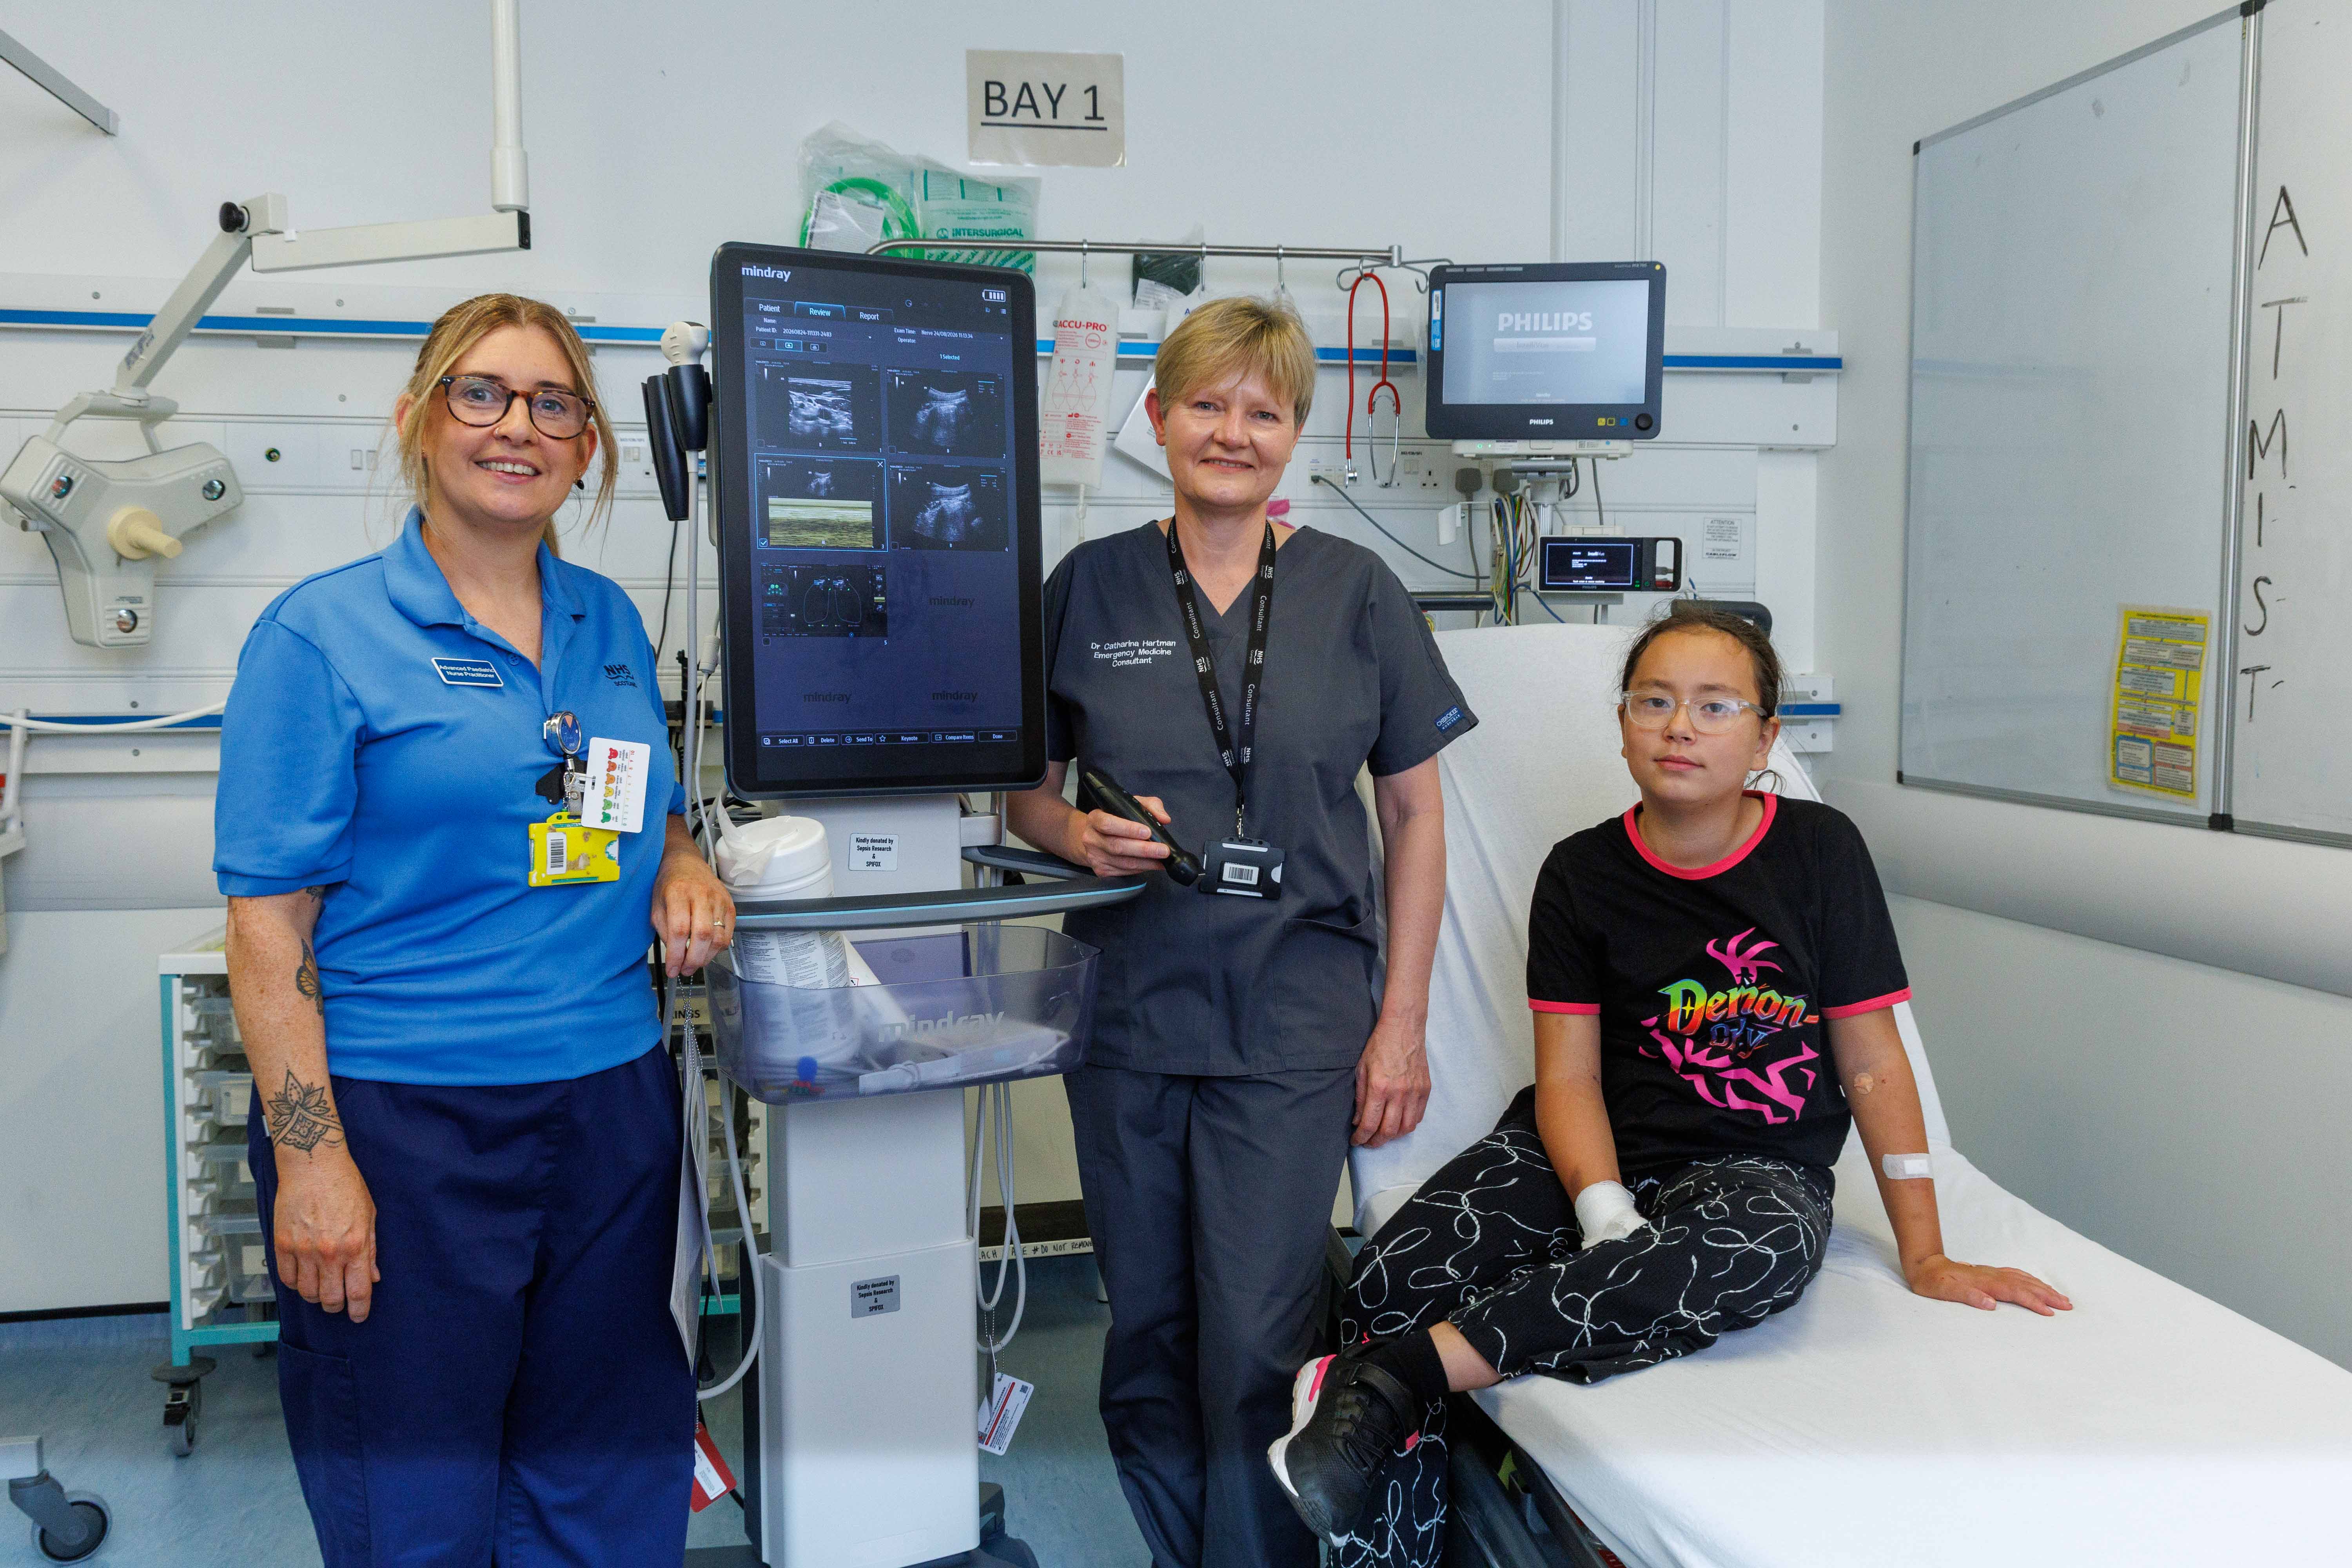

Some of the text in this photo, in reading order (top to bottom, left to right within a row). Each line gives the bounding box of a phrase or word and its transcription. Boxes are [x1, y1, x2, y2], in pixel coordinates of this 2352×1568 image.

[985, 80, 1104, 120] BAY 1
[952, 228, 1024, 237] INTERSURGICAL
[742, 266, 791, 282] mindray
[759, 304, 780, 312] Patient
[809, 308, 831, 316] Review
[860, 312, 879, 320] Report
[1499, 312, 1592, 331] PHILIPS
[783, 328, 832, 337] 20260824-111331-2483
[1058, 320, 1107, 332] ACCU-PRO
[929, 595, 975, 608] mindray
[1256, 595, 1267, 632] Consultant
[1187, 602, 1200, 639] Consultant
[1104, 640, 1139, 650] Catharina
[1094, 650, 1135, 659] Emergency
[1112, 657, 1152, 667] Consultant
[604, 664, 631, 675] NHS
[804, 691, 852, 704] mindray
[932, 691, 977, 702] mindray
[1209, 690, 1223, 730] Consultant
[1245, 684, 1255, 725] Consultant
[1436, 708, 1458, 726] CHEROKEE
[1222, 752, 1230, 767] NHS
[1658, 979, 1806, 1036] Demon
[878, 1011, 1004, 1042] mindray
[979, 1249, 997, 1260] ACH
[1041, 1244, 1048, 1253] DO
[1053, 1243, 1067, 1251] NOT
[1071, 1241, 1093, 1250] REMOVE
